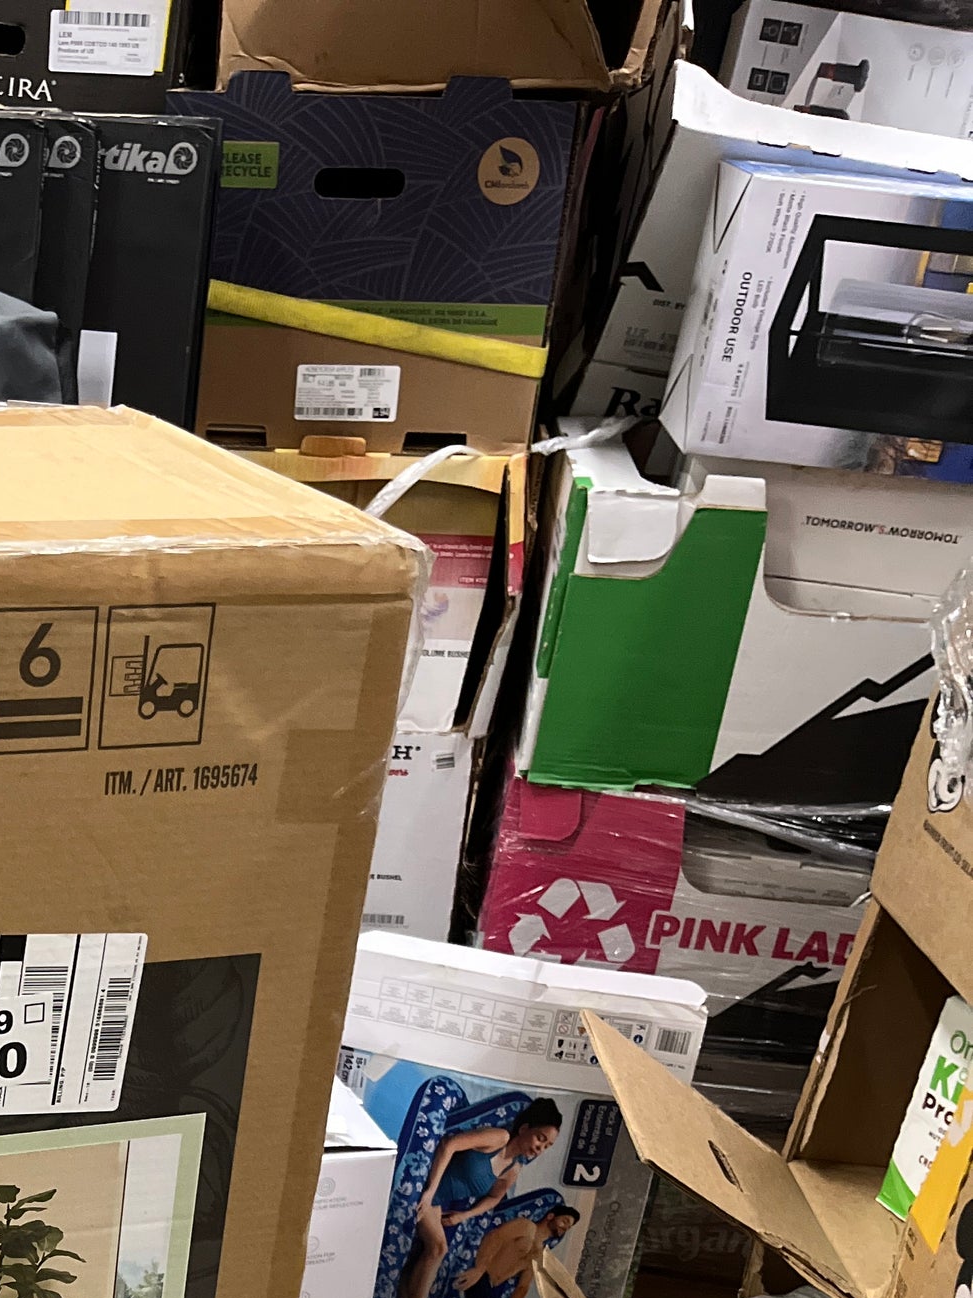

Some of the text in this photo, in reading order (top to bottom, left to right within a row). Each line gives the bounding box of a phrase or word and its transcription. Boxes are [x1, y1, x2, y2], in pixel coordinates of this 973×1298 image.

[98, 142, 165, 175] tika
[721, 271, 753, 362] OUTDOOR USE
[19, 622, 61, 688] 6
[103, 770, 138, 796] ITM.
[153, 767, 189, 795] ART.
[192, 763, 259, 790] 1695674
[651, 913, 767, 957] PINK
[579, 1104, 595, 1137] Paquete
[589, 1105, 608, 1143] Ensemble
[608, 1104, 619, 1124] Pack
[573, 1163, 601, 1183] 2
